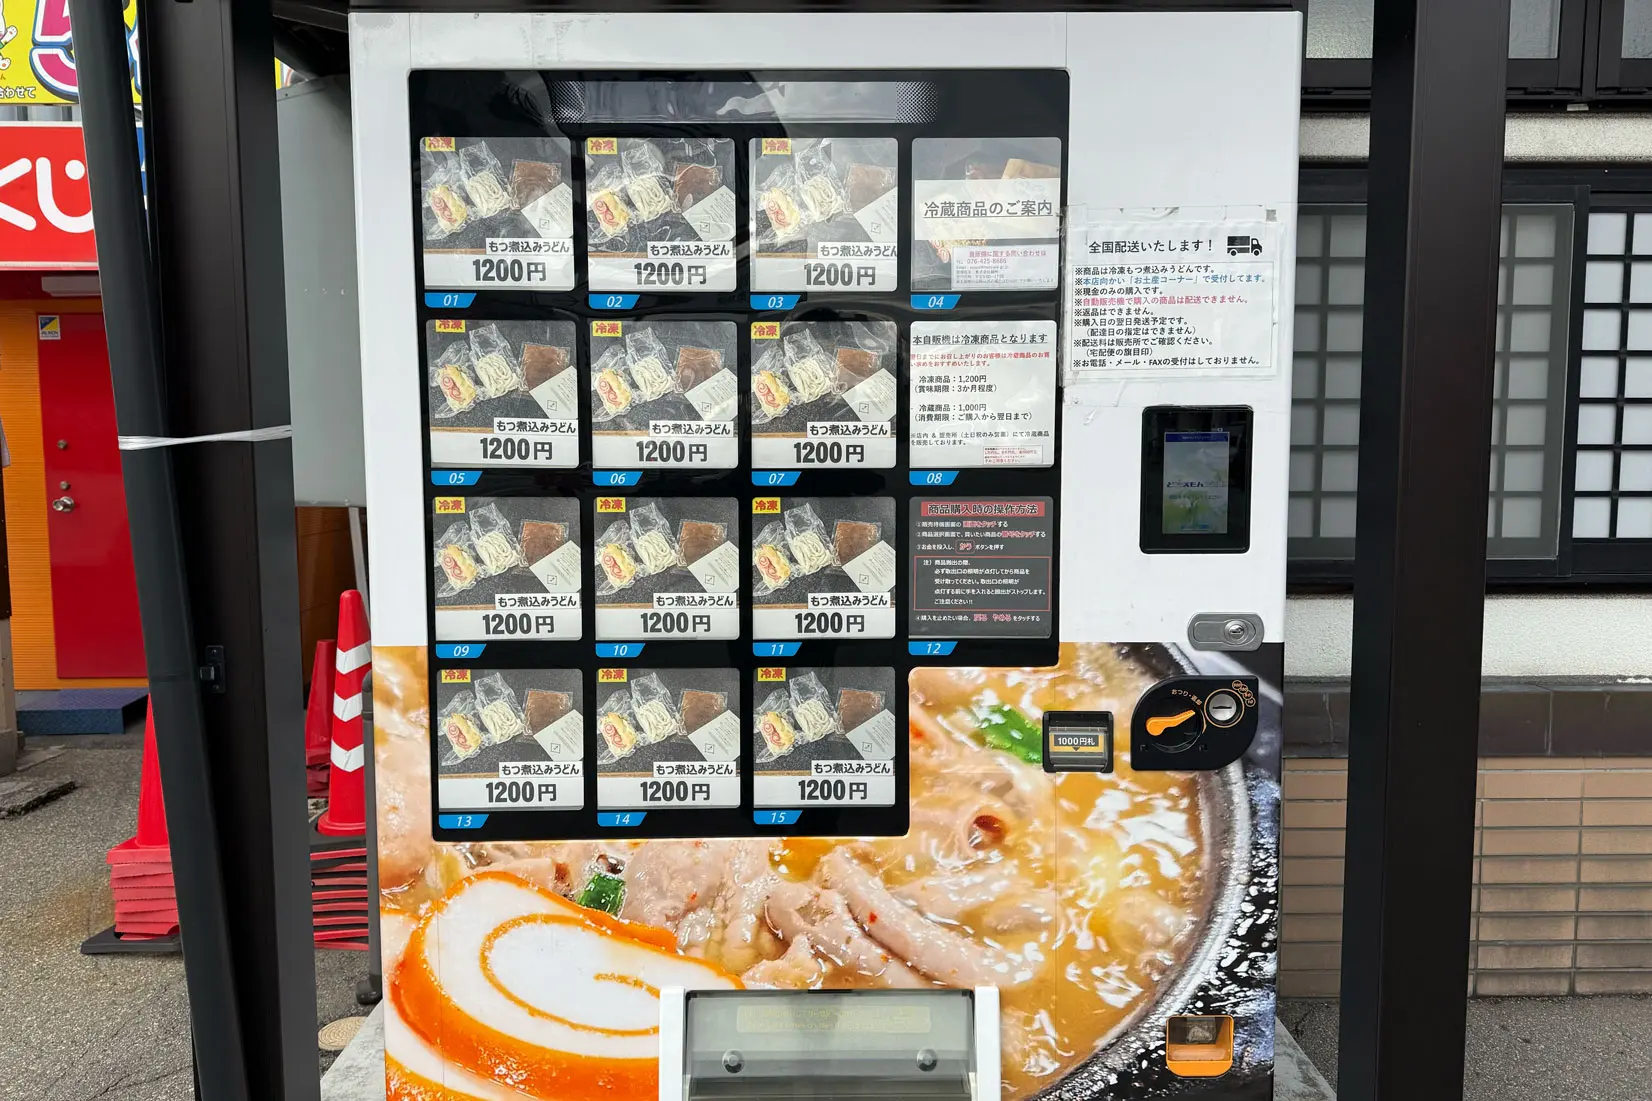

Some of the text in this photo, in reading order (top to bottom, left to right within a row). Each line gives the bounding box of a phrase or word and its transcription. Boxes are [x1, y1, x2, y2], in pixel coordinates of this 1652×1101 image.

[765, 140, 788, 152] 冷凍
[923, 200, 1053, 217] 冷蔵商品のご案内
[489, 241, 569, 254] もつ煮込みうどん
[650, 244, 730, 257] もつ煮込みうどん
[820, 245, 897, 257] もつ煮込みうどん
[1088, 238, 1214, 255] 全国配送いたします！
[473, 258, 546, 282] 1200円
[634, 262, 707, 285] 1200円
[804, 263, 875, 286] 1200円
[1074, 264, 1215, 276] ※商品は冷凍もつ煮込みうどんです。
[1074, 274, 1266, 286] ※本店向かい「お土産コーナー」で受付してます。
[1074, 286, 1164, 297] ※現金のみの購入です。
[443, 294, 459, 307] 01
[606, 296, 623, 308] 02
[768, 297, 784, 308] 03
[928, 296, 944, 308] 04
[1074, 295, 1248, 307] ※自動販売機で購入の商品は配送できません。
[1074, 307, 1154, 317] ※返品はできません。
[438, 320, 463, 330] 冷凍
[1074, 317, 1189, 327] ※購入日の翌日発送予定です。
[595, 323, 619, 334] 冷凍
[754, 325, 777, 337] 冷凍
[912, 334, 1048, 345] 本自販機は冷凍商品となります
[1073, 337, 1214, 347] ※配送料は販売所でご確認ください。
[496, 421, 576, 433] もつ煮込みうどん
[652, 423, 730, 435] もつ煮込みうどん
[809, 424, 888, 436] もつ煮込みうどん
[480, 437, 553, 460] 1200円
[636, 440, 707, 462] 1200円
[794, 442, 864, 463] 1200円
[449, 472, 465, 484] 05
[610, 473, 626, 485] 06
[768, 473, 785, 484] 07
[926, 473, 942, 484] 08
[438, 499, 462, 511] 冷凍
[599, 498, 623, 510] 冷凍
[755, 500, 778, 511] 冷凍
[928, 503, 1038, 515] 商品購入時の操作方法
[498, 595, 577, 607] もつ煮込みうどん
[656, 595, 734, 607] もつ煮込みうどん
[811, 595, 888, 606] もつ煮込みうどん
[482, 613, 554, 634] 1200円
[641, 612, 711, 633] 1200円
[795, 612, 864, 633] 1200円
[453, 645, 469, 657] 09
[613, 644, 628, 656] 10
[771, 644, 784, 655] 11
[926, 643, 941, 654] 12
[444, 670, 468, 680] 冷凍
[601, 669, 625, 680] 冷凍
[760, 668, 784, 679] 冷凍
[1057, 736, 1096, 746] 1000円札
[501, 764, 580, 776] もつ煮込みうどん
[656, 764, 733, 776] もつ煮込みうどん
[814, 763, 890, 774] もつ煮込みうどん
[485, 781, 556, 803] 1200円
[640, 781, 711, 802] 1200円
[798, 780, 867, 800] 1200円
[457, 815, 472, 827] 13
[615, 813, 630, 825] 14
[771, 812, 786, 823] 15
